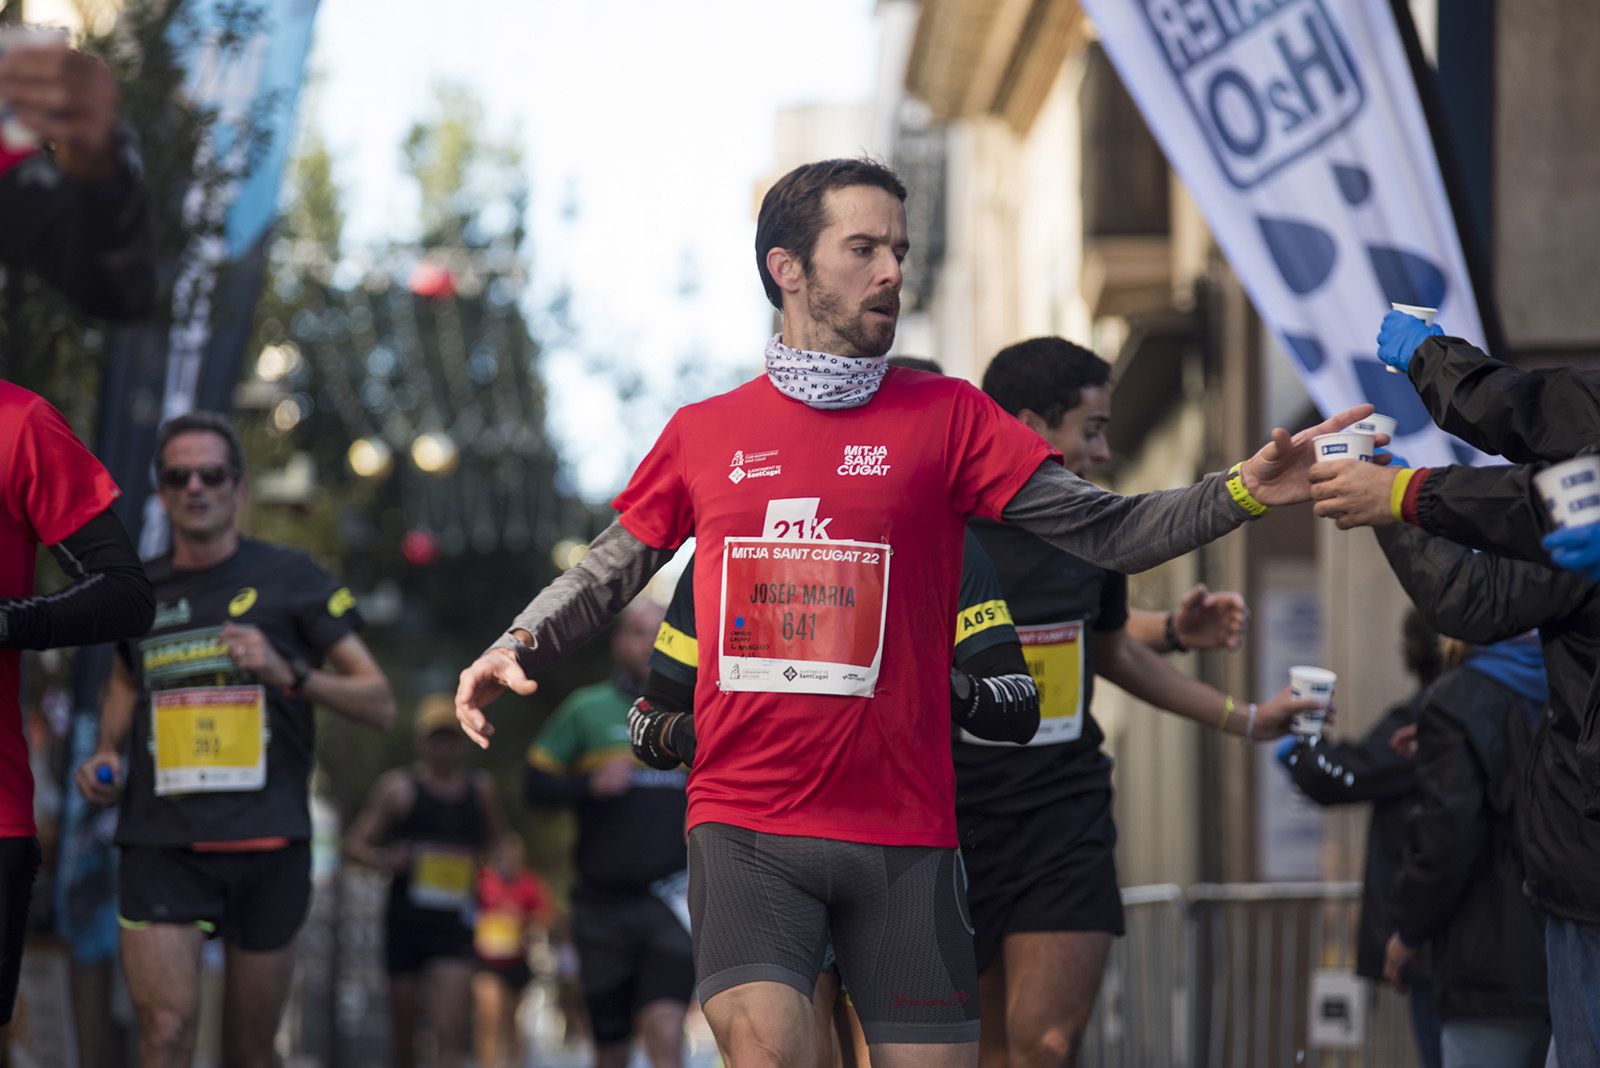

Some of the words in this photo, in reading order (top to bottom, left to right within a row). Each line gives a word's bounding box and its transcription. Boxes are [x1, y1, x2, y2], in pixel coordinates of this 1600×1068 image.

[811, 383, 844, 391] NOW
[844, 445, 888, 456] MITJA
[844, 455, 886, 466] SANT
[837, 464, 891, 476] CUGAT
[773, 517, 833, 540] 21K
[731, 547, 769, 559] MITJA
[772, 547, 809, 560] SANT
[811, 549, 861, 562] CUGAT
[861, 552, 880, 564] 22
[750, 583, 796, 604] JOSEP
[802, 584, 855, 608] MARIA
[782, 611, 817, 641] 641
